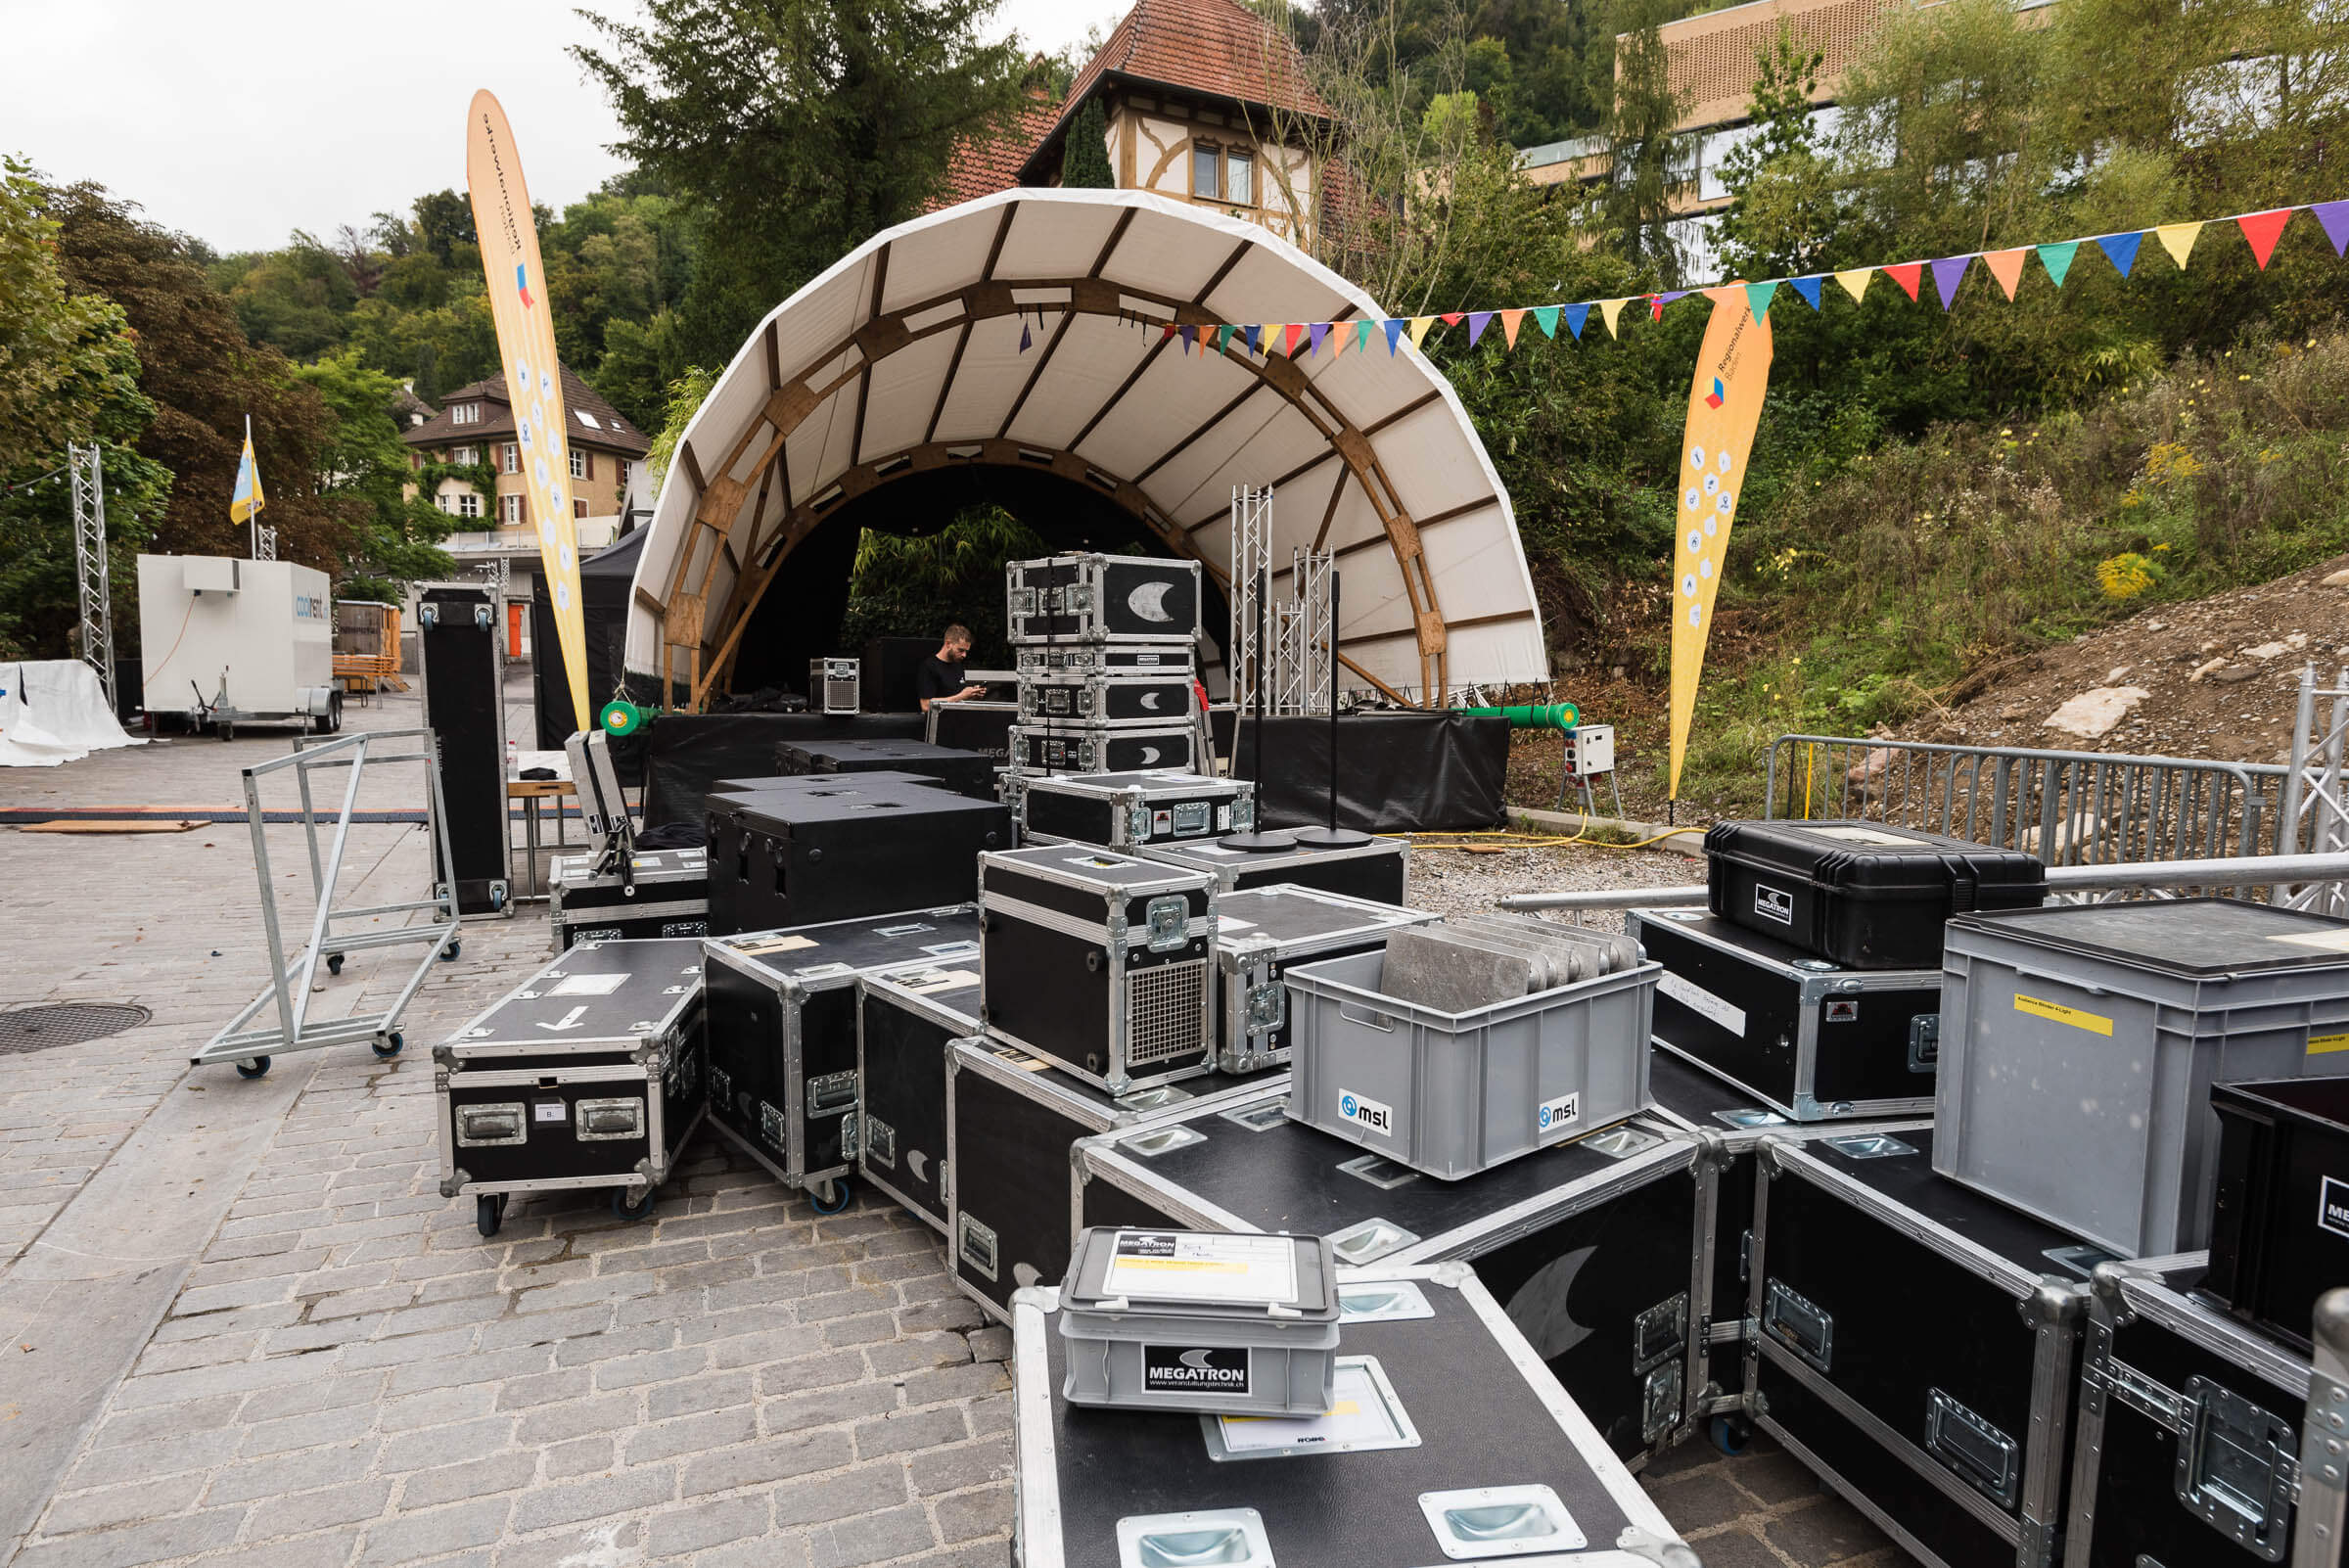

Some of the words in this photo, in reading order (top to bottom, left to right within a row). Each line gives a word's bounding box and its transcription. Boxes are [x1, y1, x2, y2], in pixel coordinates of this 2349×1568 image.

[1718, 305, 1752, 372] Regionalwerk
[1758, 899, 1789, 915] MEGATRON
[1359, 1106, 1389, 1130] msl
[1552, 1098, 1577, 1123] msl
[1120, 1239, 1174, 1249] MEGATRON
[1149, 1367, 1244, 1381] MEGATRON
